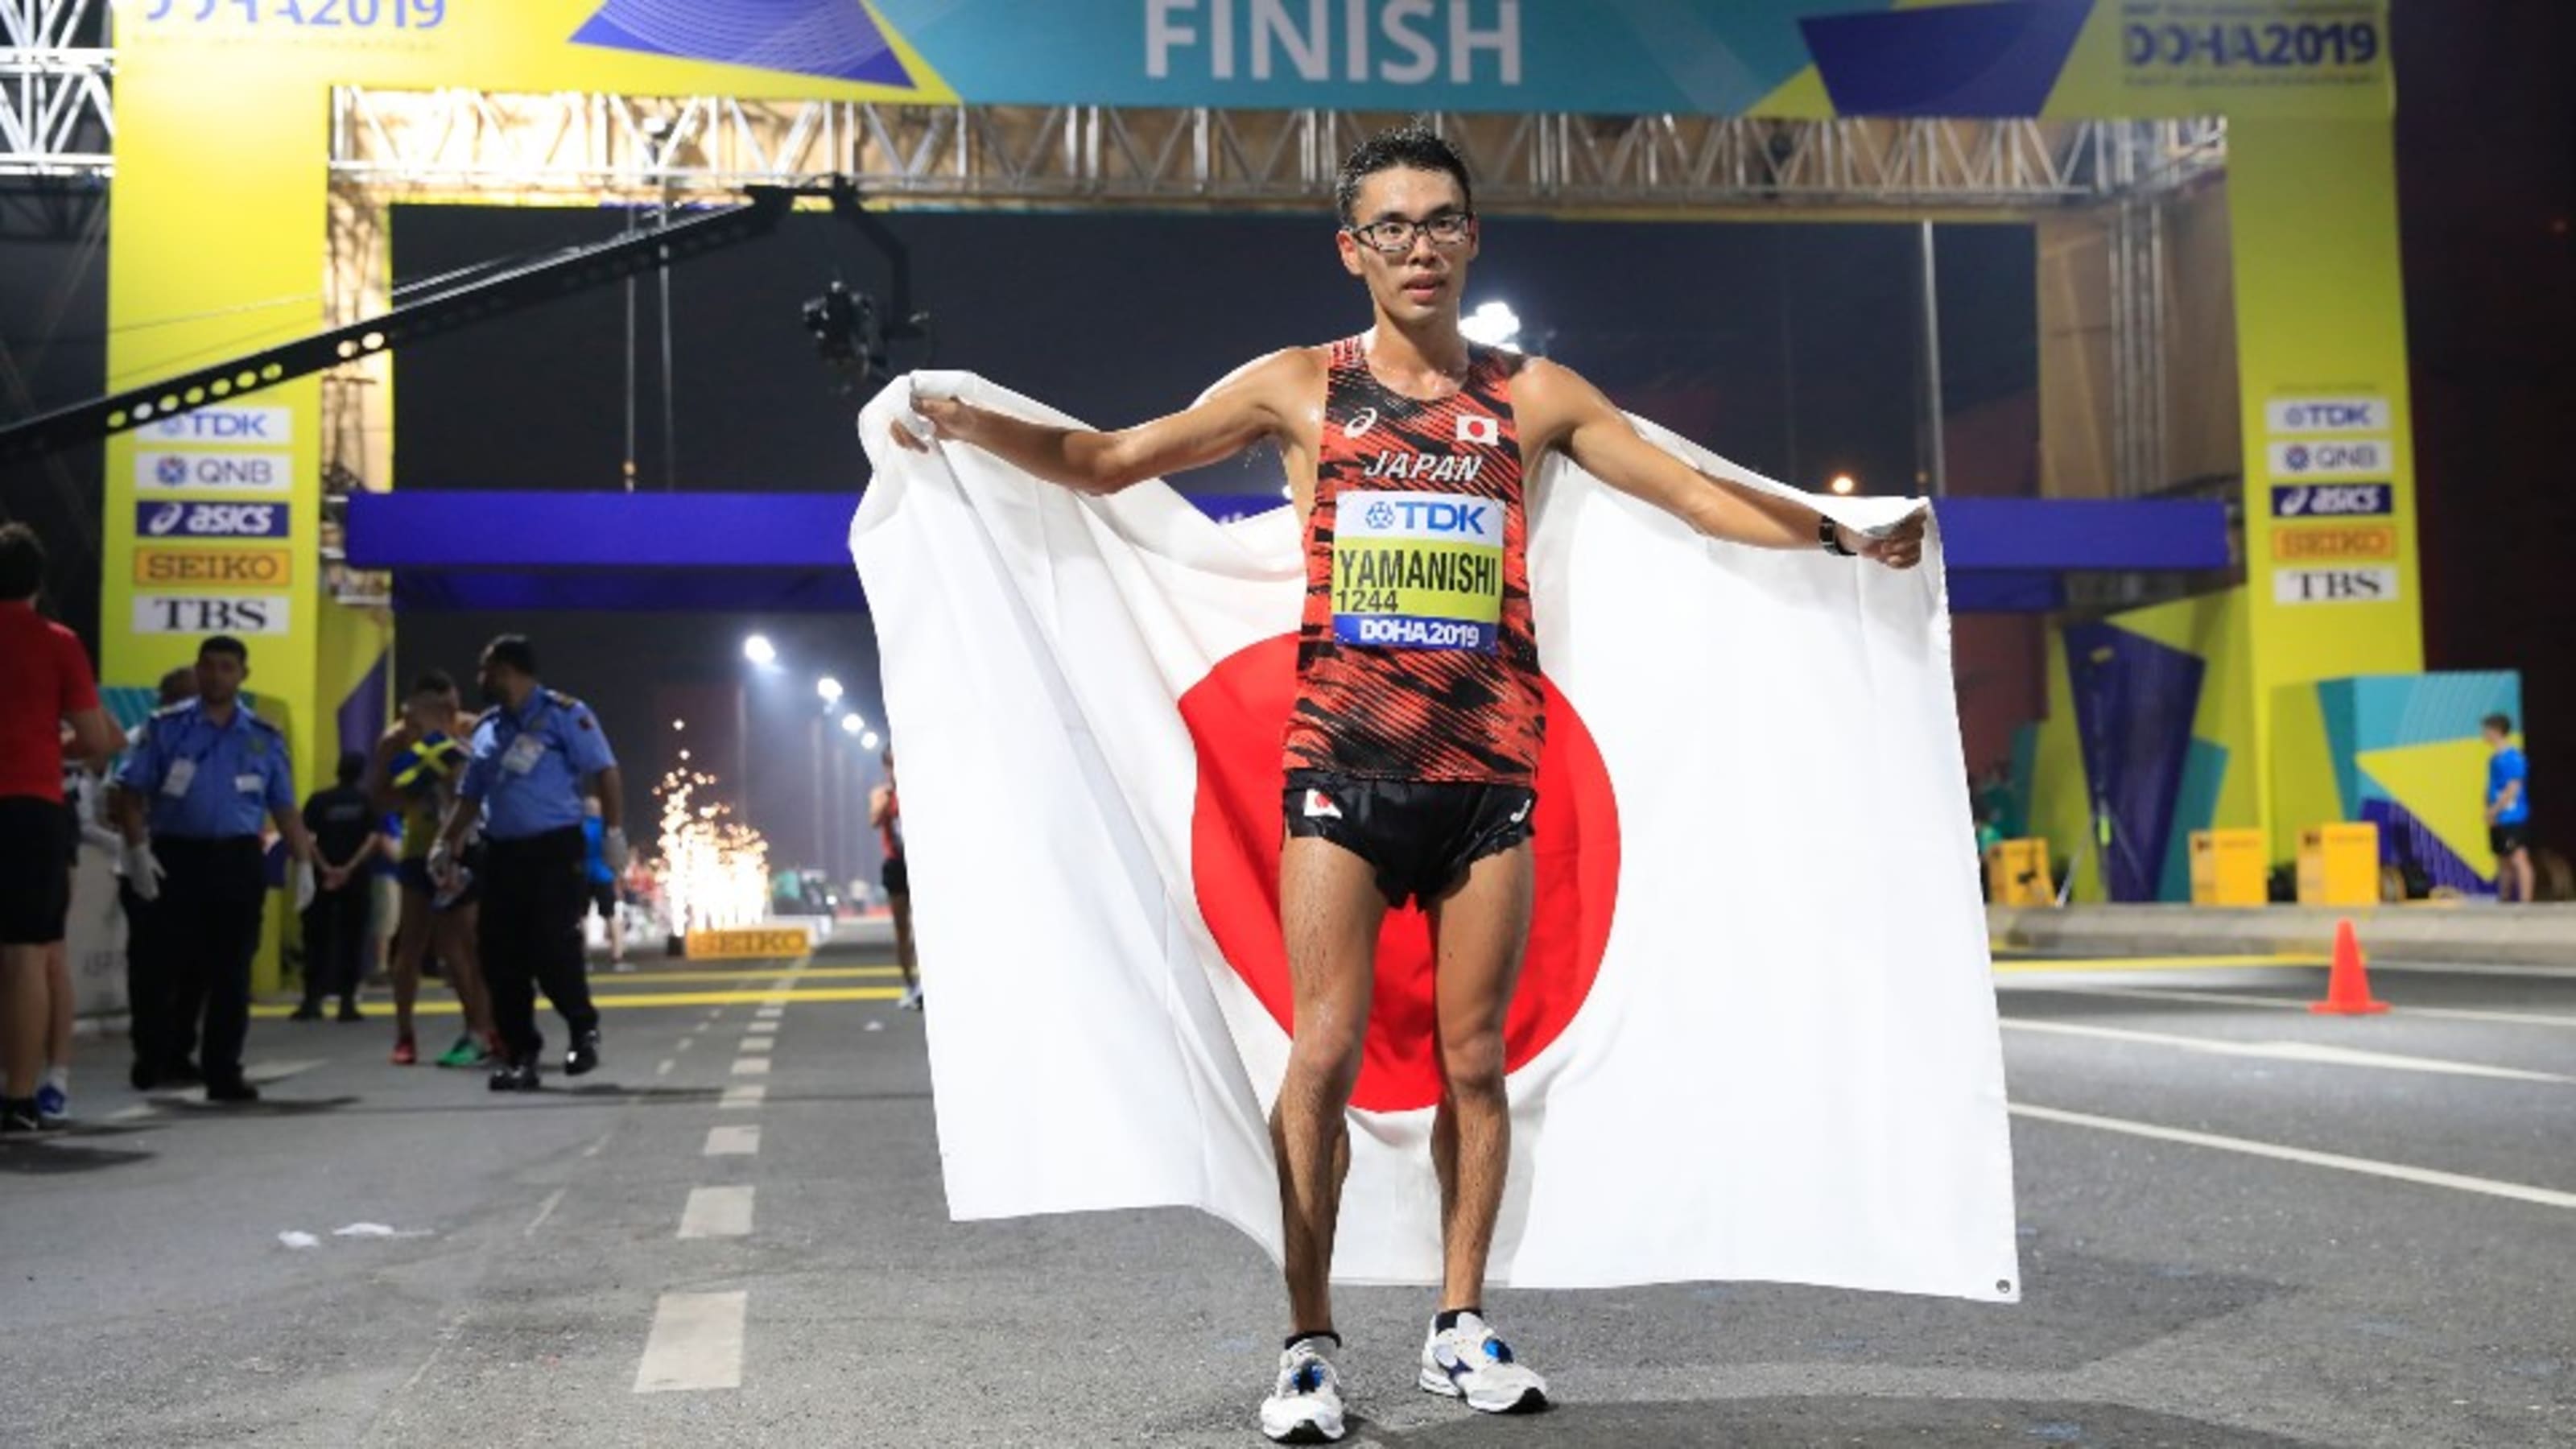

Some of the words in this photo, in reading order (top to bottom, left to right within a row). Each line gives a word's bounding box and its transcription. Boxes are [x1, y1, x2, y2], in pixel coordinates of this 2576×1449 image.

[1145, 0, 1521, 85] FINISH
[192, 413, 267, 436] TDK
[2307, 406, 2372, 427] TDK
[197, 458, 272, 485] QNB
[1363, 450, 1484, 481] JAPAN
[187, 504, 274, 534] asics
[1395, 501, 1488, 534] TDK
[148, 555, 279, 580] SEIKO
[1338, 549, 1496, 597] YAMANISHI
[2289, 572, 2381, 599] TBS
[154, 599, 267, 630] TBS
[1336, 589, 1399, 613] 1244
[1359, 618, 1480, 647] DOHA2019
[691, 929, 808, 955] SEIKO
